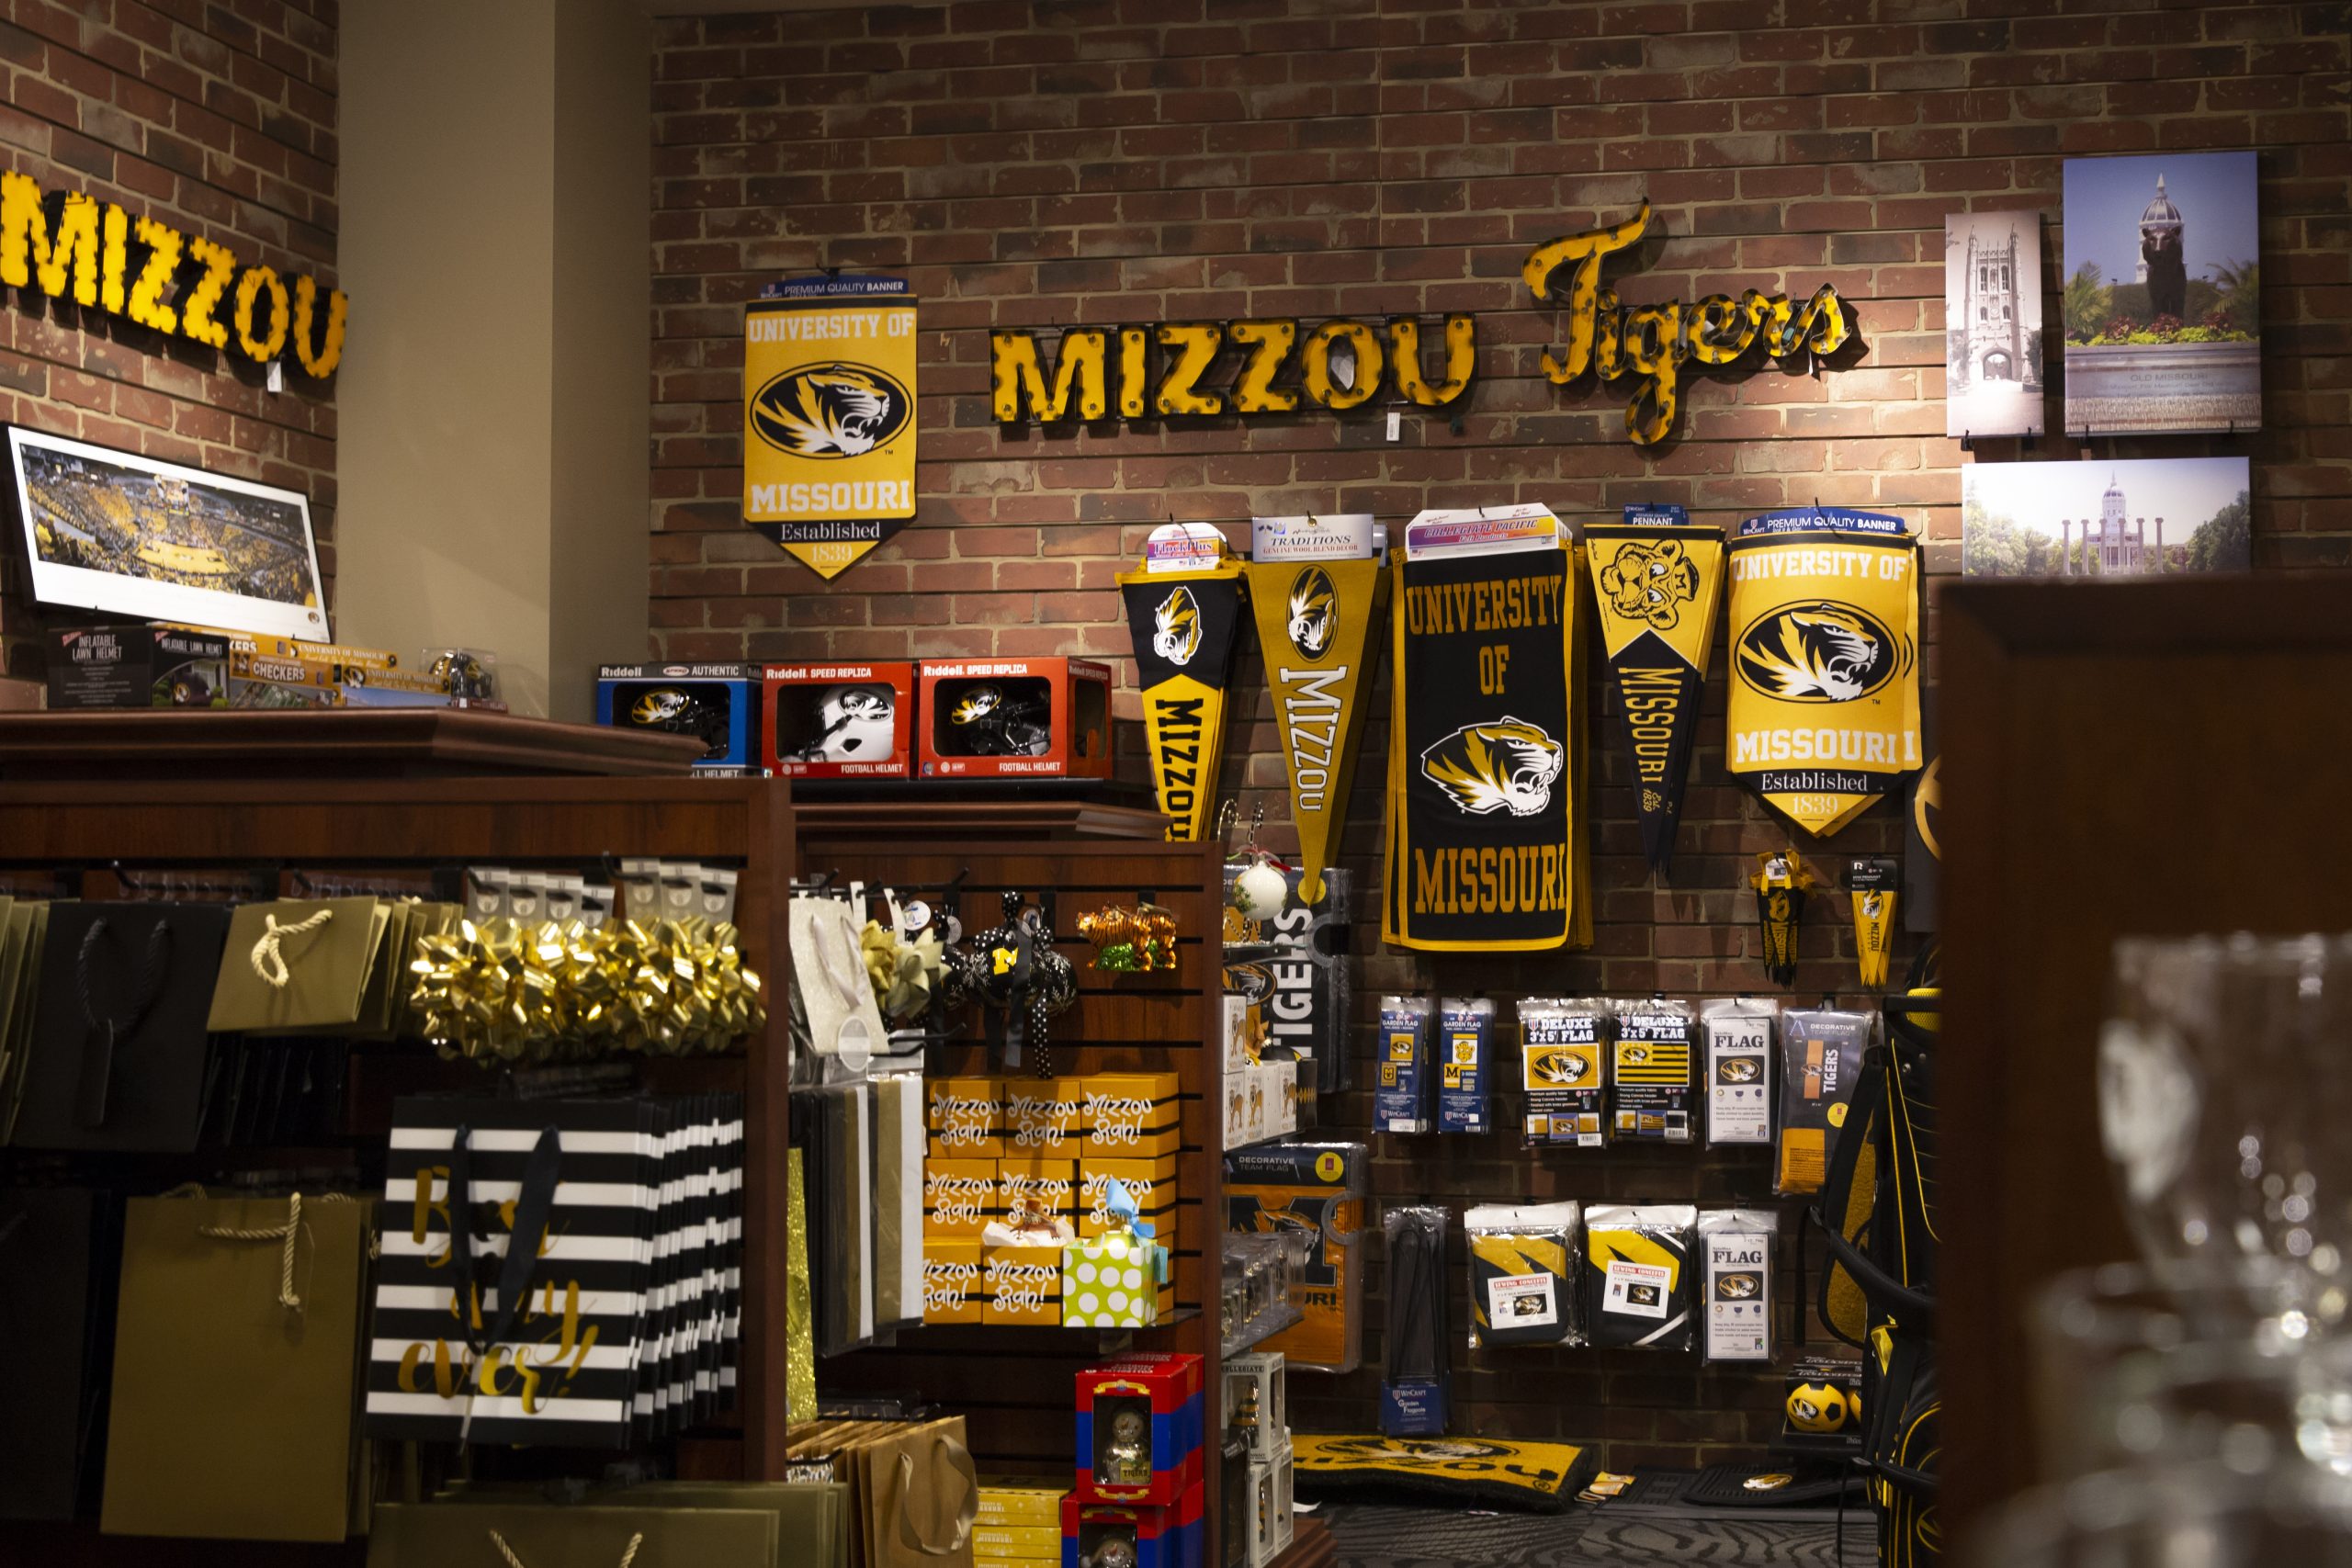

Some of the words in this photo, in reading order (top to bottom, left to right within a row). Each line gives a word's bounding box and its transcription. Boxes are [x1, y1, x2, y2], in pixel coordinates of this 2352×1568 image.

[0, 169, 348, 378] MIZZOU
[785, 284, 825, 295] PREMIUM
[827, 282, 865, 294] QUALITY
[866, 281, 904, 292] BANNER
[749, 316, 880, 343] UNIVERSITY
[888, 313, 914, 337] OF
[990, 314, 1475, 423] MIZZOU
[1522, 196, 1852, 446] Tigers
[2131, 374, 2153, 382] OLD
[751, 479, 910, 513] MISSOURI
[781, 522, 880, 541] Established
[1633, 517, 1673, 525] PENNANT
[1767, 517, 1811, 530] PREMIUM
[1814, 517, 1855, 529] QUALITY
[1858, 519, 1896, 532] BANNER
[1272, 535, 1351, 546] TRADITIONS
[810, 543, 853, 563] 1839
[1734, 551, 1872, 581] UNIVERSITY
[1879, 556, 1907, 581] OF
[1407, 575, 1562, 635] UNIVERSITY
[78, 634, 116, 648] INFLATABLE
[299, 644, 341, 657] UNIVERSITY
[72, 647, 92, 661] LAWN
[96, 646, 122, 660] HELMET
[254, 661, 305, 682] CHECKERS
[601, 666, 642, 677] Riddell
[692, 666, 739, 676] AUTHENTIC
[766, 669, 807, 679] Riddell
[810, 669, 835, 678] SPEED
[837, 668, 872, 678] REPLICA
[924, 666, 963, 677] Riddell
[967, 665, 992, 675] SPEED
[993, 664, 1027, 675] REPLICA
[1479, 644, 1510, 695] OF
[1618, 667, 1685, 783] MISSOURI
[1280, 665, 1348, 812] MIZZOU
[1736, 728, 1896, 764] MISSOURI
[841, 764, 874, 773] FOOTBALL
[876, 763, 903, 773] HELMET
[999, 762, 1032, 772] FOOTBALL
[1033, 761, 1060, 772] HELMET
[1761, 773, 1868, 792] Established
[1643, 788, 1652, 812] 1839
[1792, 795, 1838, 815] 1839
[1415, 842, 1566, 914] MISSOURI
[1871, 922, 1880, 953] MIZZOU
[1541, 1017, 1592, 1030] DELUXE
[1633, 1016, 1684, 1028] DELUXE
[1562, 1030, 1594, 1041] FLAG
[1653, 1028, 1685, 1039] FLAG
[1714, 1035, 1764, 1048] FLAG
[1823, 1048, 1838, 1093] TIGERS
[932, 1092, 1001, 1120] Mizzou
[1008, 1093, 1076, 1120] Mizzou
[1083, 1091, 1152, 1119] Mizzou
[940, 1115, 991, 1146] Rah!
[1015, 1116, 1068, 1147] Rah!
[1091, 1114, 1144, 1145] Rah!
[925, 1170, 994, 1197] Mizzou
[1001, 1171, 1069, 1198] Mizzou
[933, 1194, 984, 1224] Rah!
[1713, 1251, 1763, 1264] FLAG
[985, 1257, 1057, 1284] Mizzou
[993, 1282, 1047, 1313] Rah!
